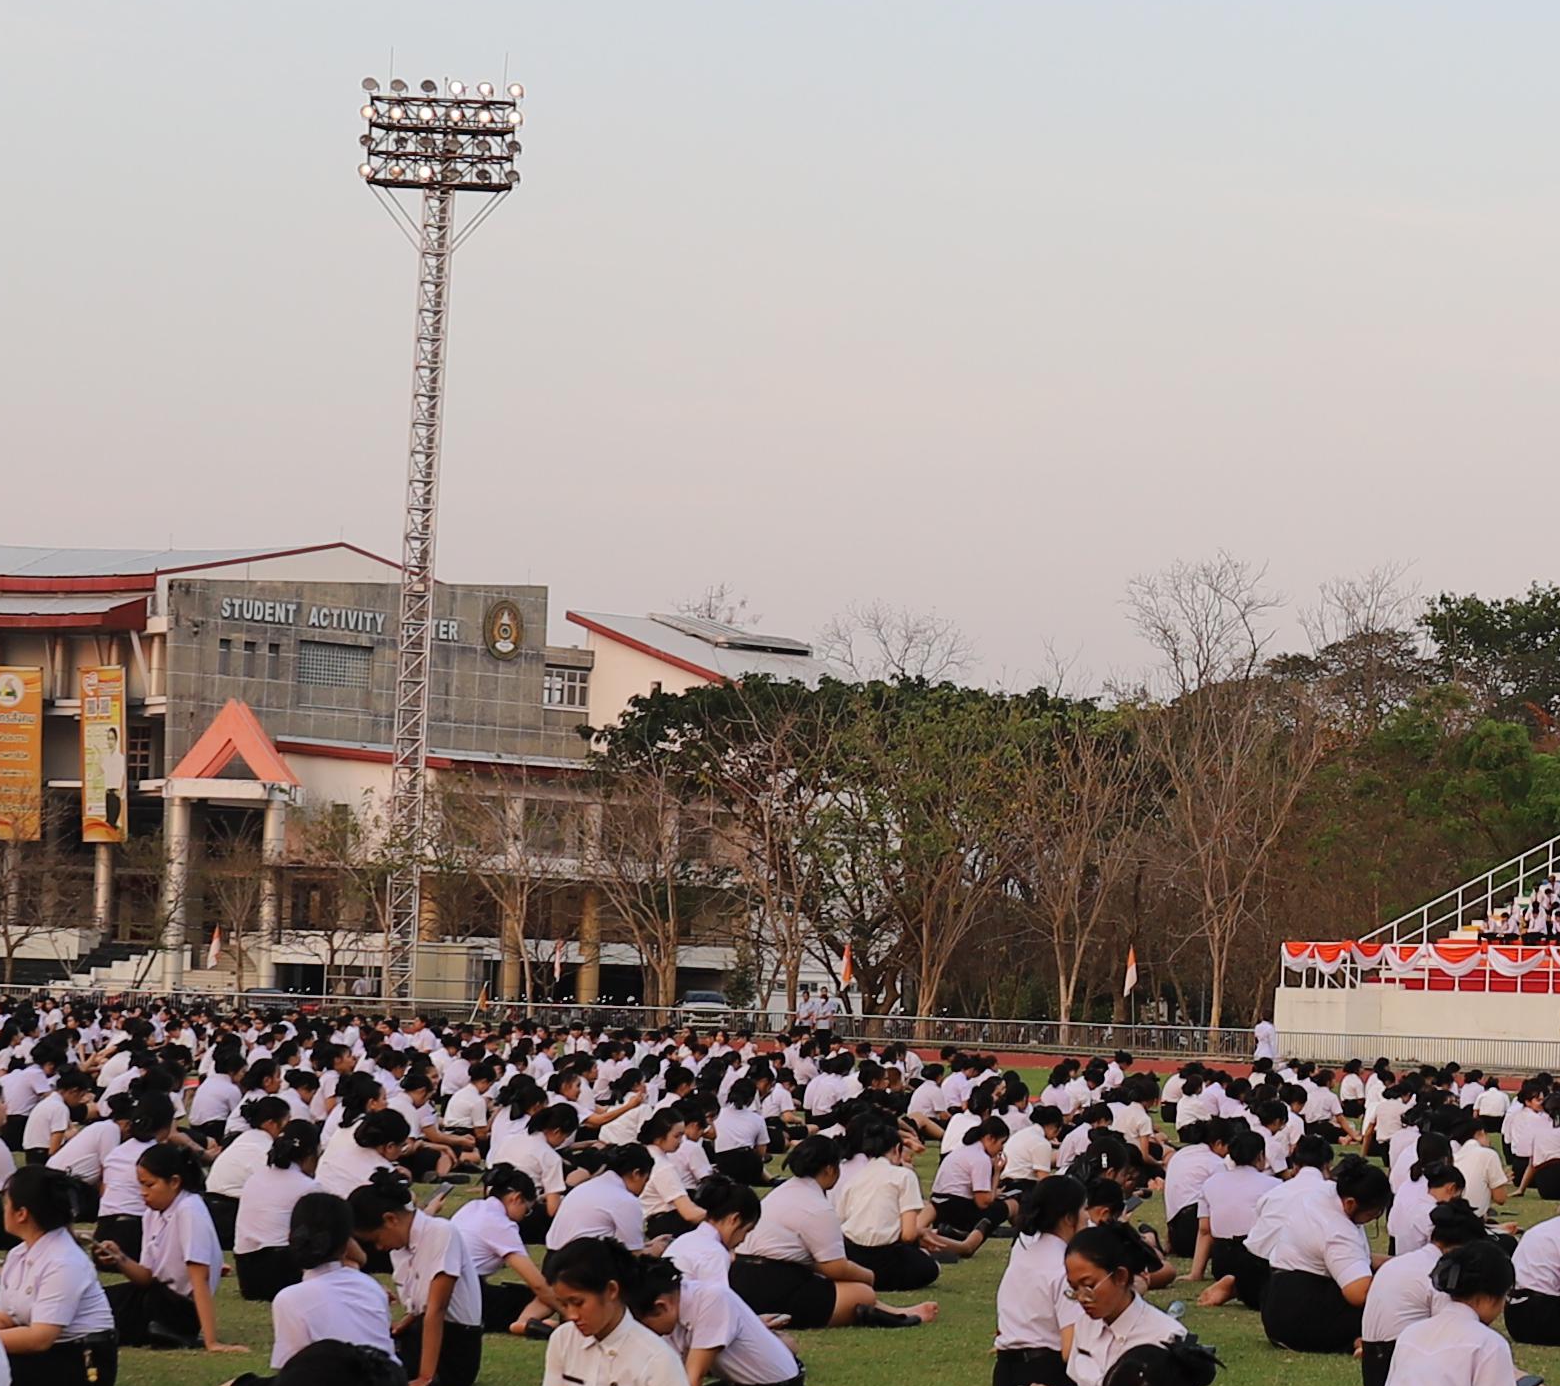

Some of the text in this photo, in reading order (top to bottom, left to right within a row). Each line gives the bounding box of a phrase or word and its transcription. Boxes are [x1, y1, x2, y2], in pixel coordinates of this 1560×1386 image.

[220, 597, 459, 640] STUDENT ACTIVITY ETER
